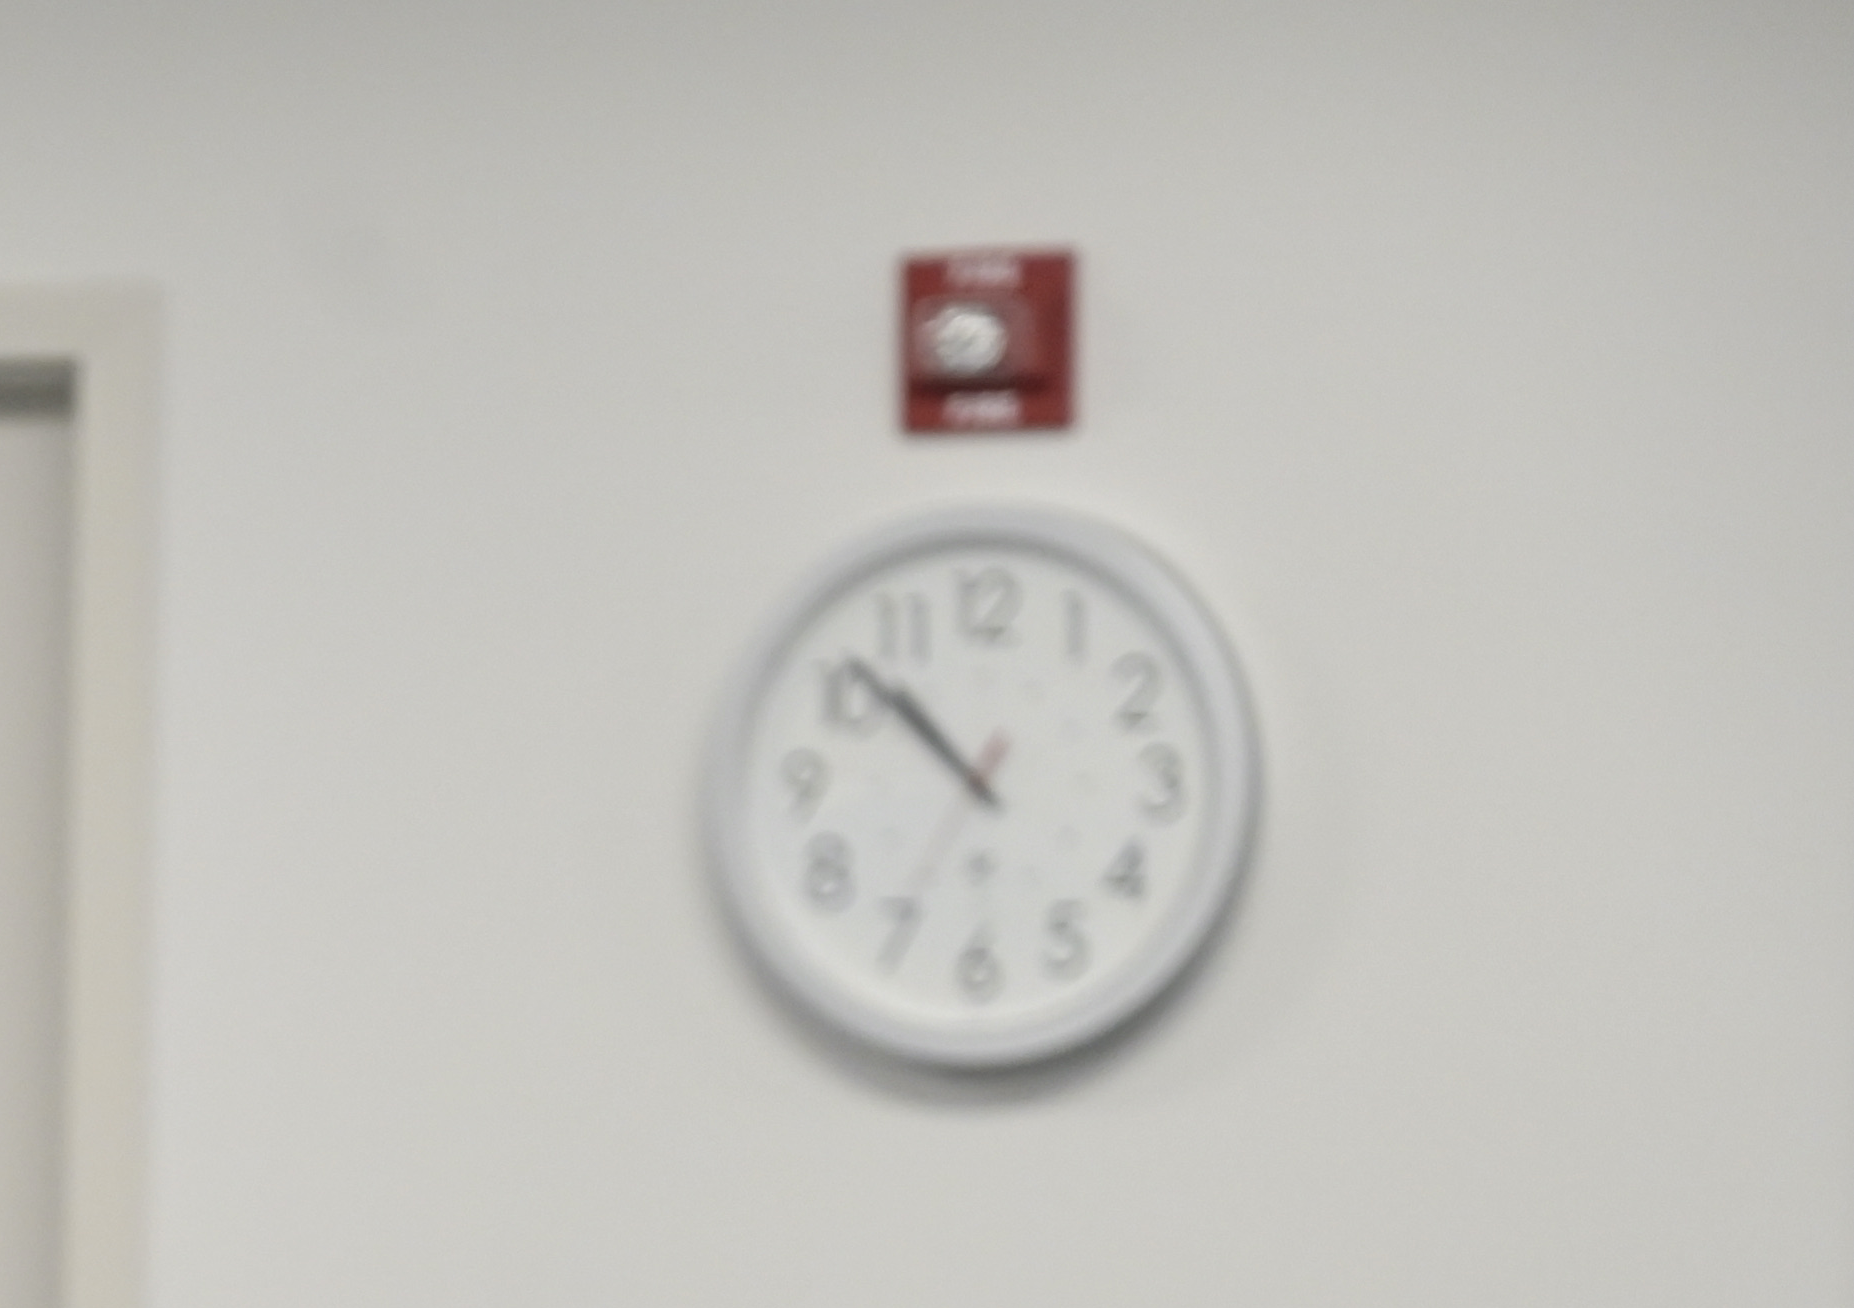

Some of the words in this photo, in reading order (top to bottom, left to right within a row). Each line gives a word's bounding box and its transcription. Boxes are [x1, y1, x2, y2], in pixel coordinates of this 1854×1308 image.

[879, 590, 930, 668] 11
[950, 563, 1023, 648] 12
[1065, 590, 1086, 662] 1
[1111, 650, 1161, 731] 2
[781, 747, 828, 822] 9
[1140, 742, 1185, 826] 3
[805, 831, 856, 914] 8
[1104, 840, 1149, 904] 4
[877, 895, 924, 966] 7
[956, 922, 1003, 1003] 6
[1041, 897, 1088, 980] 5
